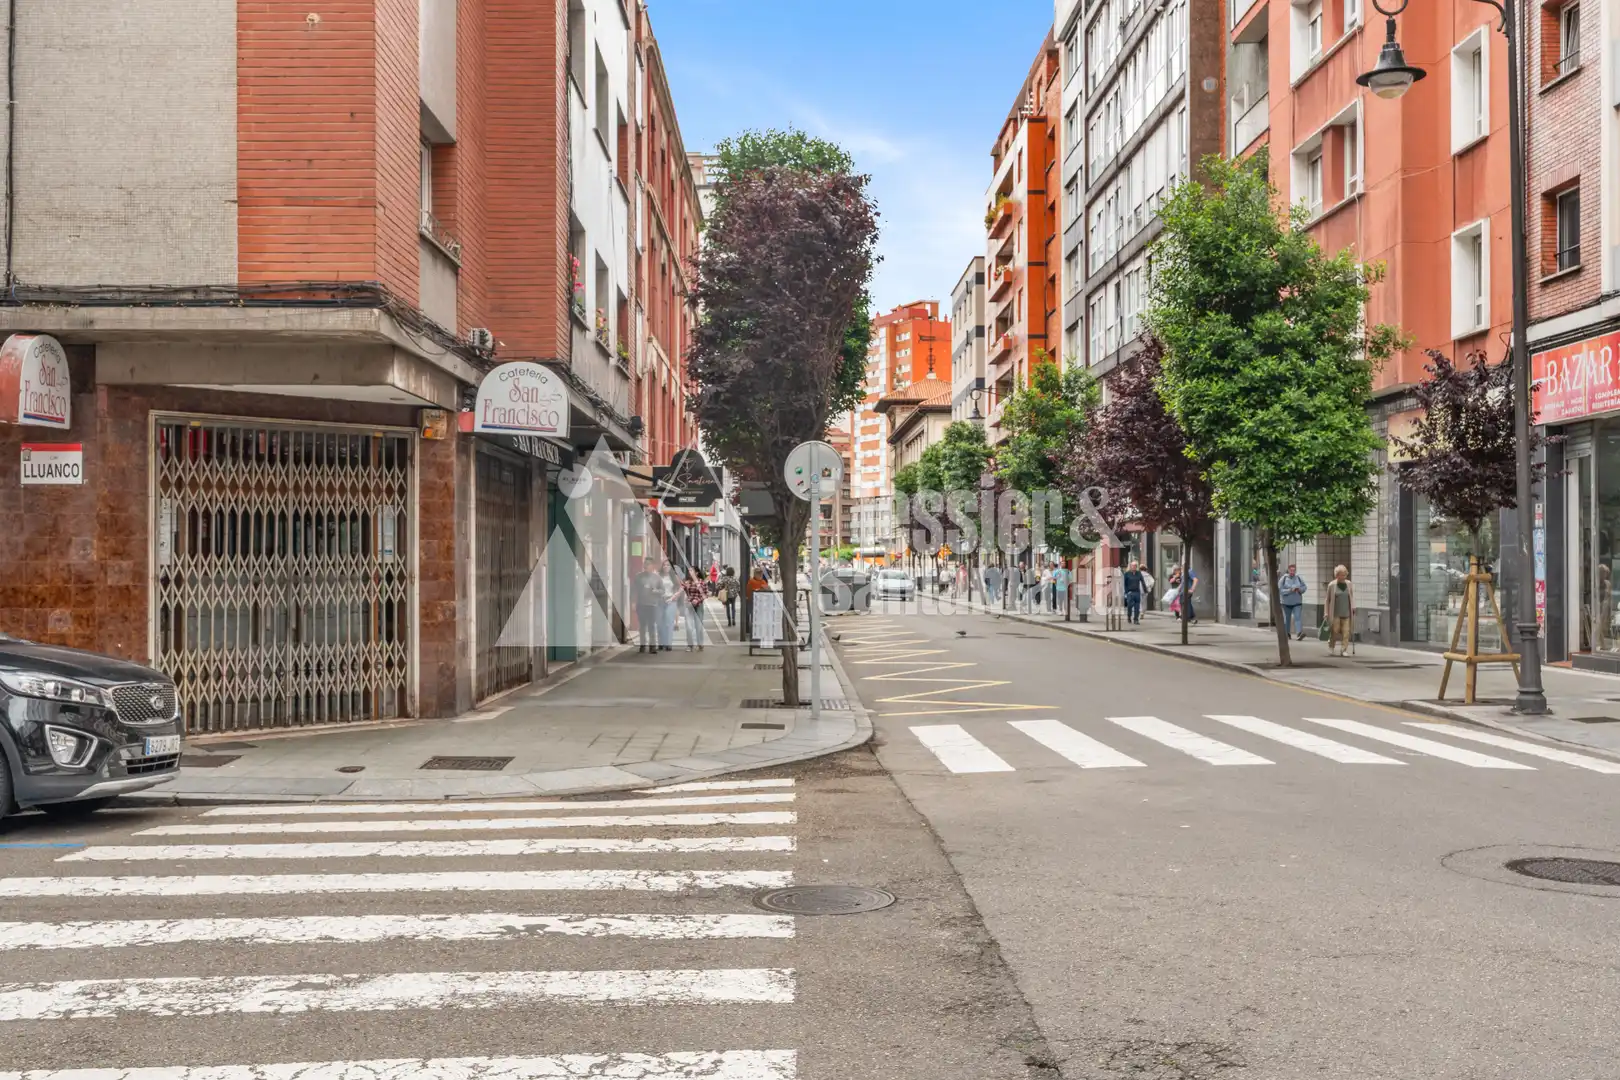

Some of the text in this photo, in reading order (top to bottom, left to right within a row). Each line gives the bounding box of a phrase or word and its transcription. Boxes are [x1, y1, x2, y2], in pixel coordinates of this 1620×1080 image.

[39, 355, 56, 387] San
[1547, 346, 1613, 396] BAZAR
[24, 380, 67, 418] Francisco
[509, 378, 539, 403] San
[483, 398, 560, 427] Francisco
[24, 463, 80, 478] LLUANCO
